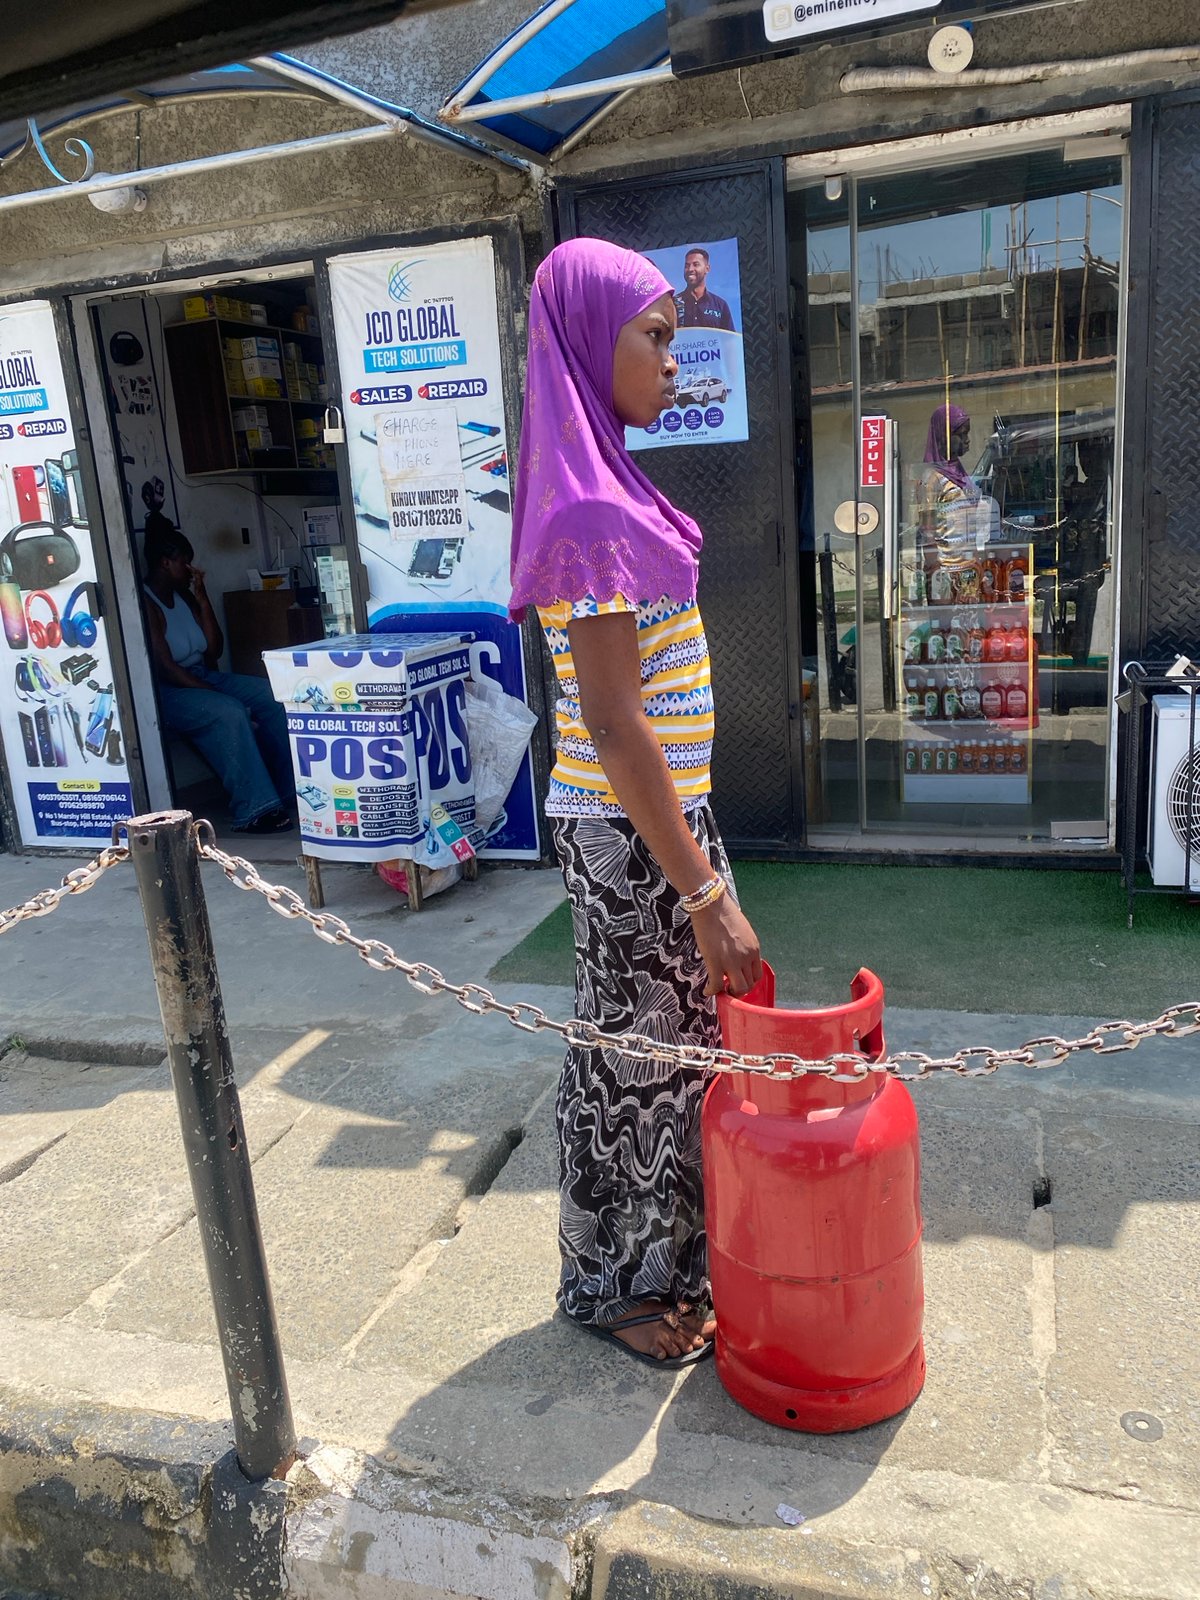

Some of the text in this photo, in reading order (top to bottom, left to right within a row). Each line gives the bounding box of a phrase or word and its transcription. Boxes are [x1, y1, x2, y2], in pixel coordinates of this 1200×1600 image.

[365, 304, 461, 346] JCD GLOBAL
[682, 340, 707, 351] SHARE
[707, 338, 719, 348] OF
[370, 344, 459, 368] TECH SOLUTIONS
[0, 392, 43, 410] SOLUTIONS
[361, 381, 484, 403] SALES REPAIR
[25, 421, 65, 435] REPAIR
[383, 417, 438, 438] CHARGE
[405, 438, 439, 453] PHONE
[394, 450, 432, 470] HERE
[867, 440, 879, 484] PULL
[390, 488, 459, 508] KINDLY WHATSAPP
[408, 670, 417, 685] CD
[417, 664, 438, 682] GLOBAL
[438, 660, 452, 675] TECH
[452, 657, 462, 671] SOL
[357, 684, 406, 694] WITHDRAWAL
[287, 718, 410, 732] JCD GLOBAL TECH SOL 3.
[412, 679, 472, 799] POS
[296, 736, 407, 781] POS
[359, 782, 416, 794] WITHDRAWAL
[366, 802, 415, 812] TRANSFER
[369, 794, 411, 803] DEPOSIT
[361, 808, 419, 821] CABLE BILLS
[365, 830, 391, 838] AIRTIME
